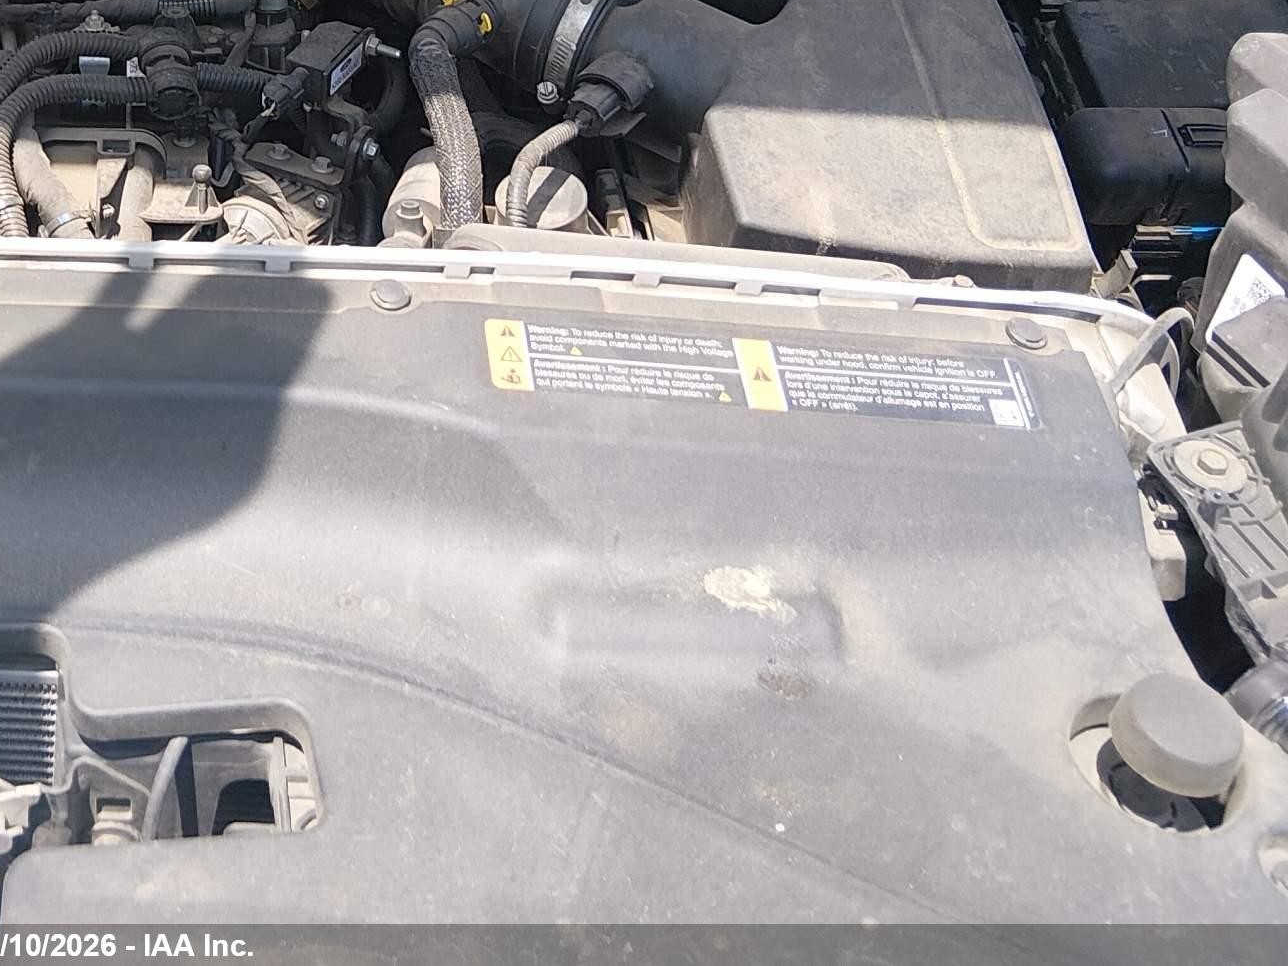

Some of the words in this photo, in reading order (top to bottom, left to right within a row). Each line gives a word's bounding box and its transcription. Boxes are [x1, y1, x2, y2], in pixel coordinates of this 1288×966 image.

[776, 346, 819, 357] Warning:
[820, 349, 831, 357] To
[833, 351, 863, 360] reduce
[864, 353, 879, 361] the
[936, 359, 964, 367] before
[779, 356, 813, 366] working
[868, 362, 901, 370] confirm
[902, 365, 933, 374] vehicle
[934, 367, 966, 376] ignition
[976, 370, 998, 378] OFF.
